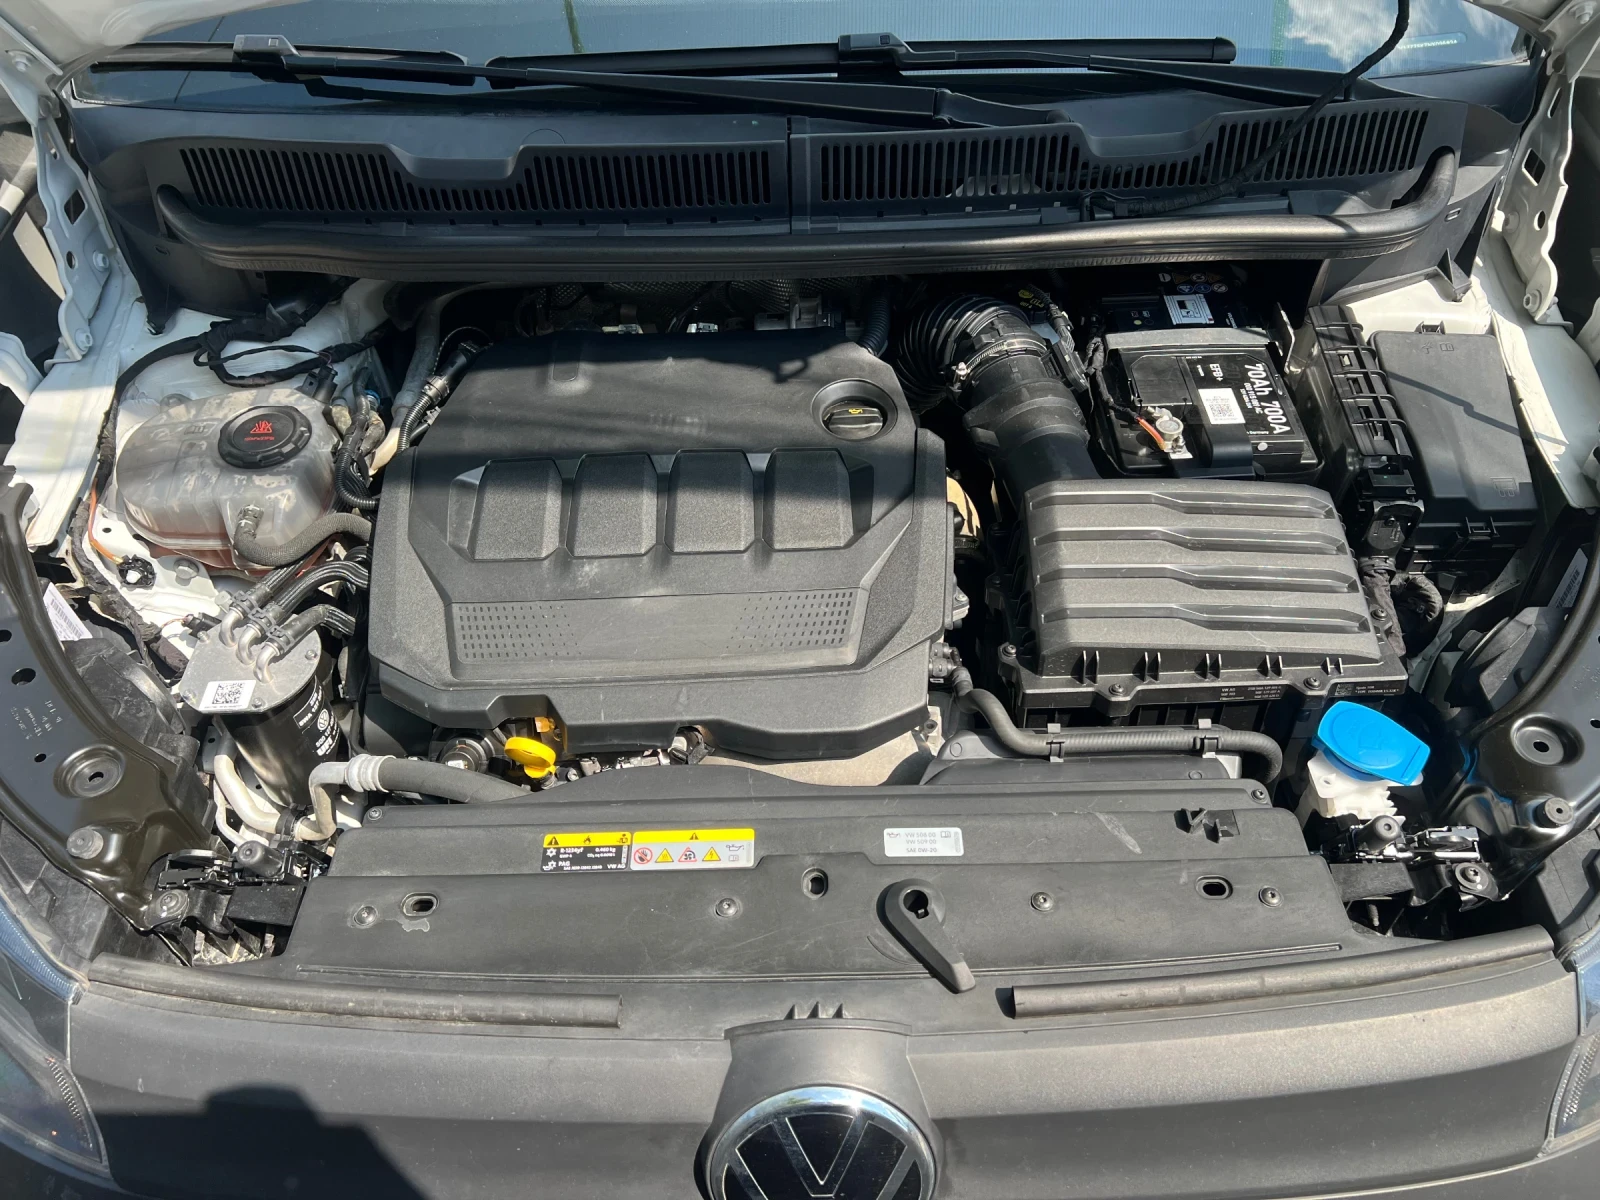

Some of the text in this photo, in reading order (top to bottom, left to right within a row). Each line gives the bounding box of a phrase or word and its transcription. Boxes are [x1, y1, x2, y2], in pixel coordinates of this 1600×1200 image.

[1209, 363, 1224, 382] EFB+
[1244, 363, 1291, 434] 70Ah 700A
[316, 735, 333, 757] UFI
